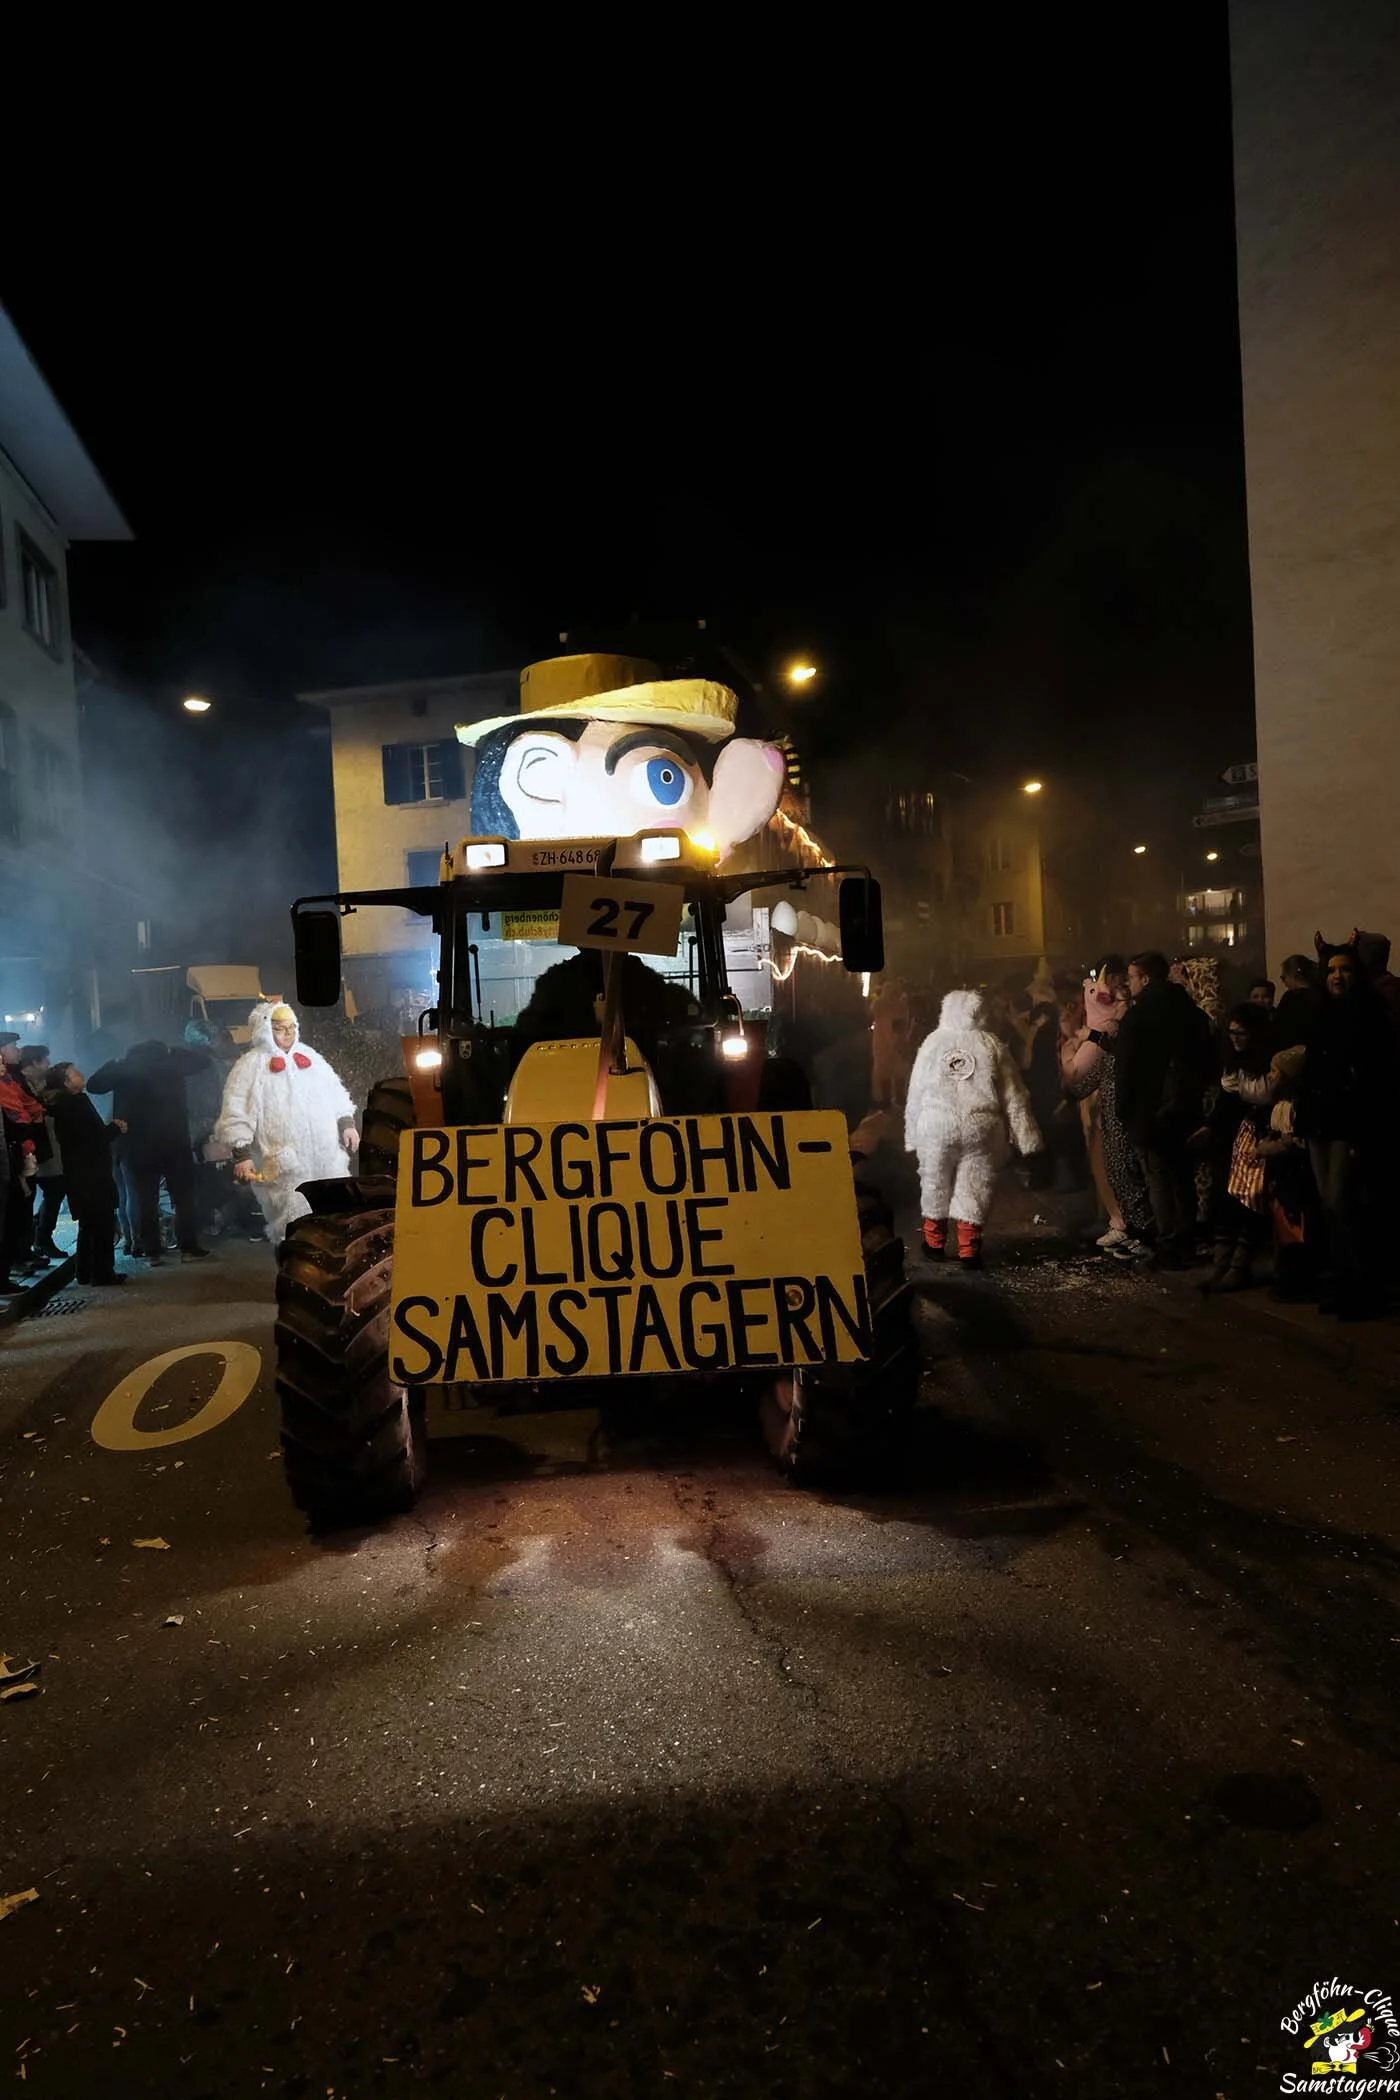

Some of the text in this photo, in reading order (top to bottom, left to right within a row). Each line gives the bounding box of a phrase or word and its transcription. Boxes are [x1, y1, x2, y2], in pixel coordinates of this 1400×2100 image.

[586, 897, 655, 940] 27
[470, 1197, 735, 1287] CLIQUE
[393, 1274, 871, 1383] SAMSTAGERN
